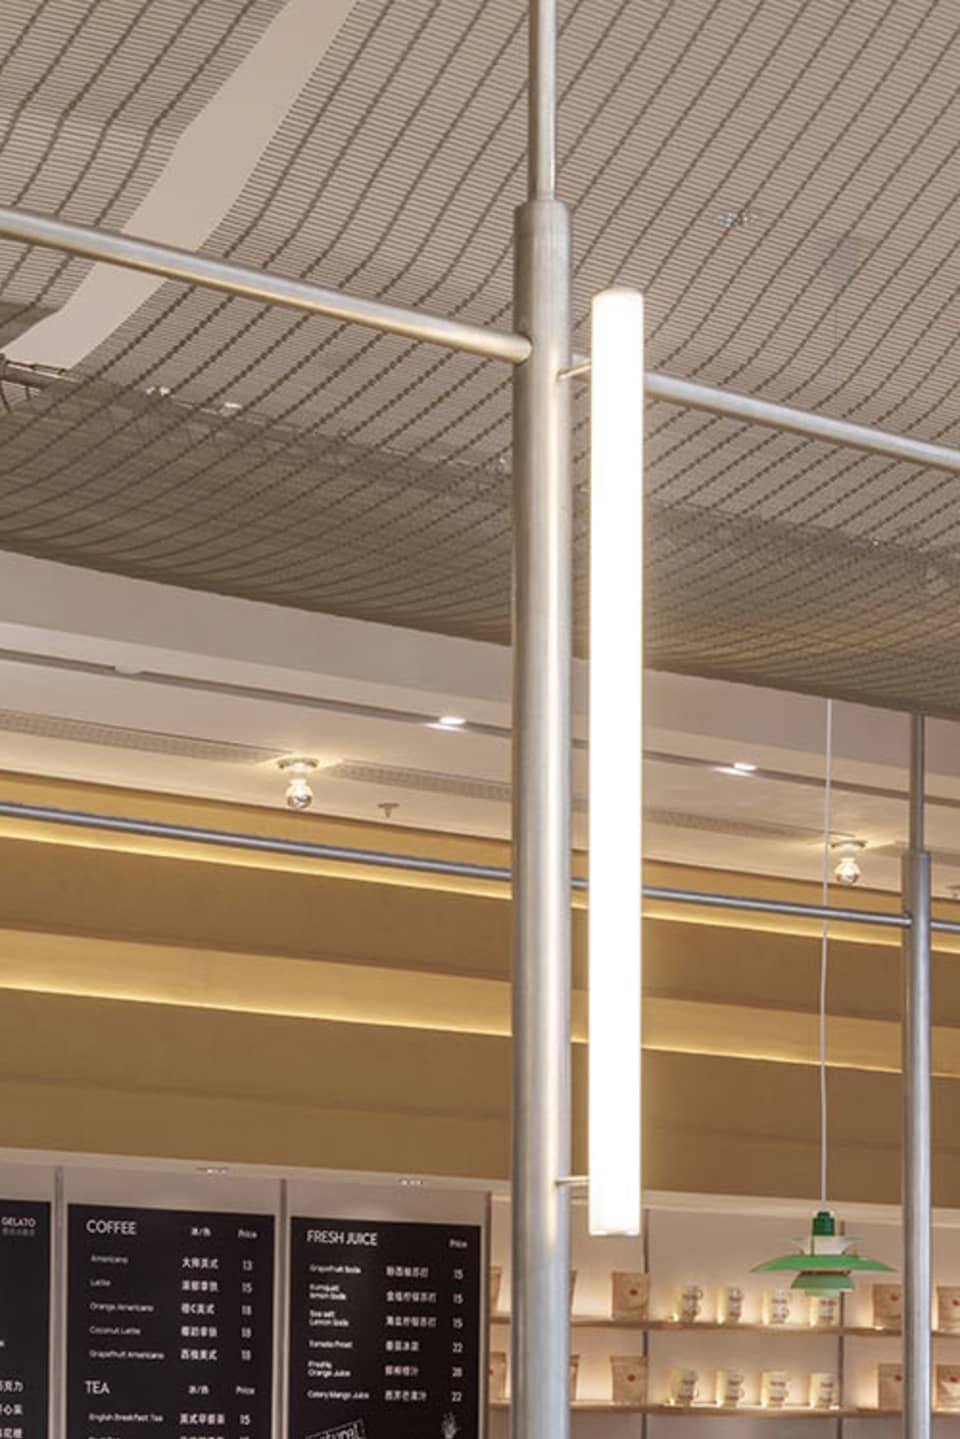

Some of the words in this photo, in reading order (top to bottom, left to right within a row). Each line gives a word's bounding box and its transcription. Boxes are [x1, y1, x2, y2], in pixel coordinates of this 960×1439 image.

[1, 1217, 36, 1228] GELATO
[86, 1219, 137, 1236] COFFEE
[306, 1229, 344, 1245] FRESH
[346, 1232, 378, 1247] JUICE
[85, 1380, 111, 1394] TEA
[235, 1385, 256, 1396] Price
[240, 1414, 251, 1426] 15
